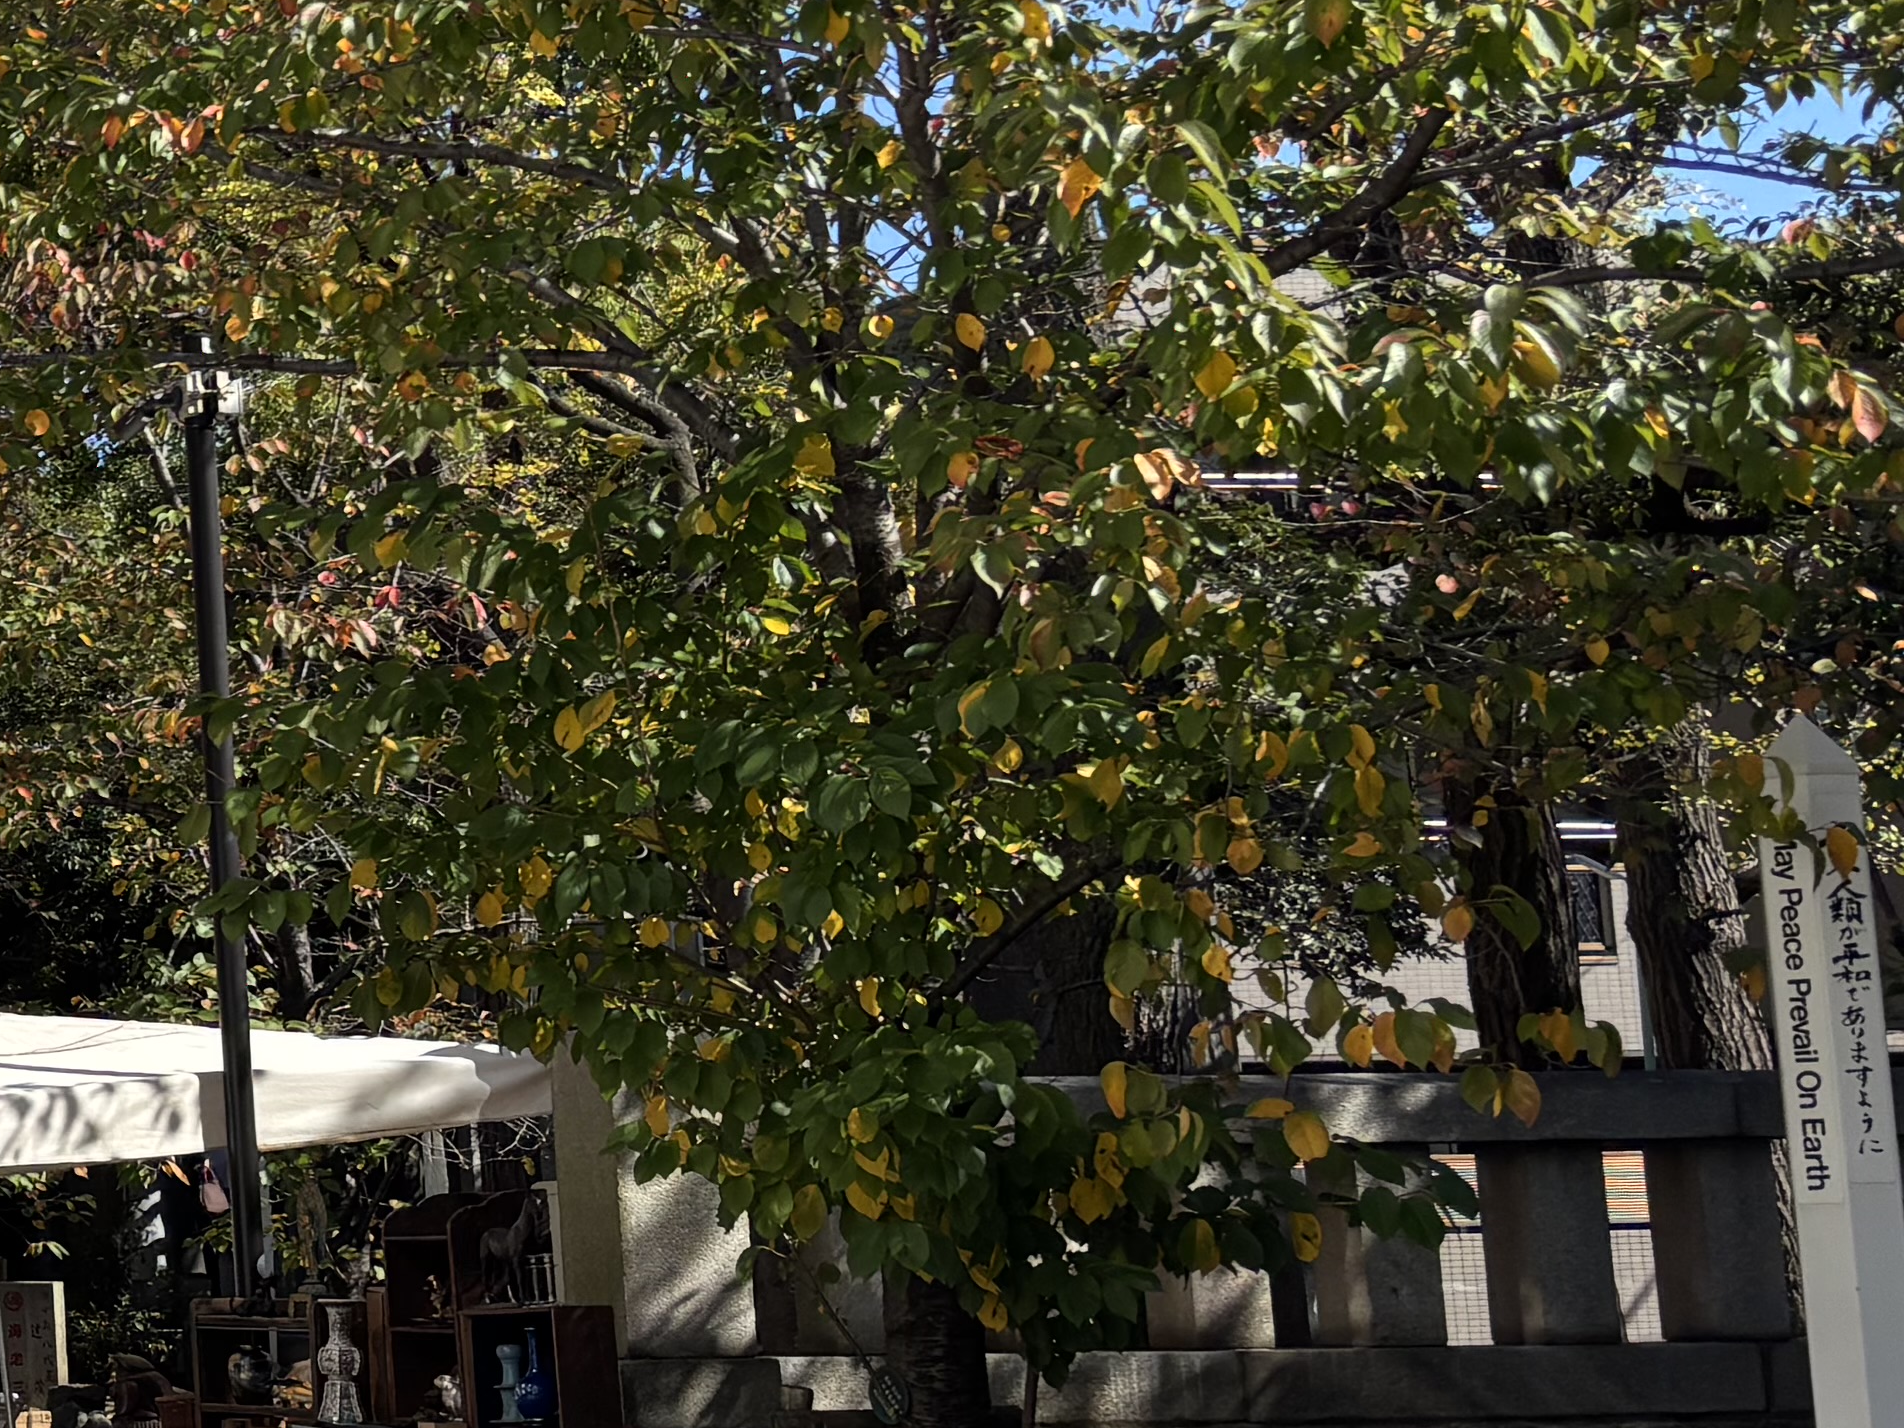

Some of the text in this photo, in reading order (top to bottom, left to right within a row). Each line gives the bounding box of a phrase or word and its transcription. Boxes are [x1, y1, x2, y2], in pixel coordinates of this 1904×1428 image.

[1779, 888, 1804, 970] Peace
[1787, 978, 1819, 1063] Prevail
[1819, 840, 1884, 1155] 人類が平和でありますように
[1796, 1070, 1822, 1109] On
[1801, 1118, 1831, 1191] Earth
